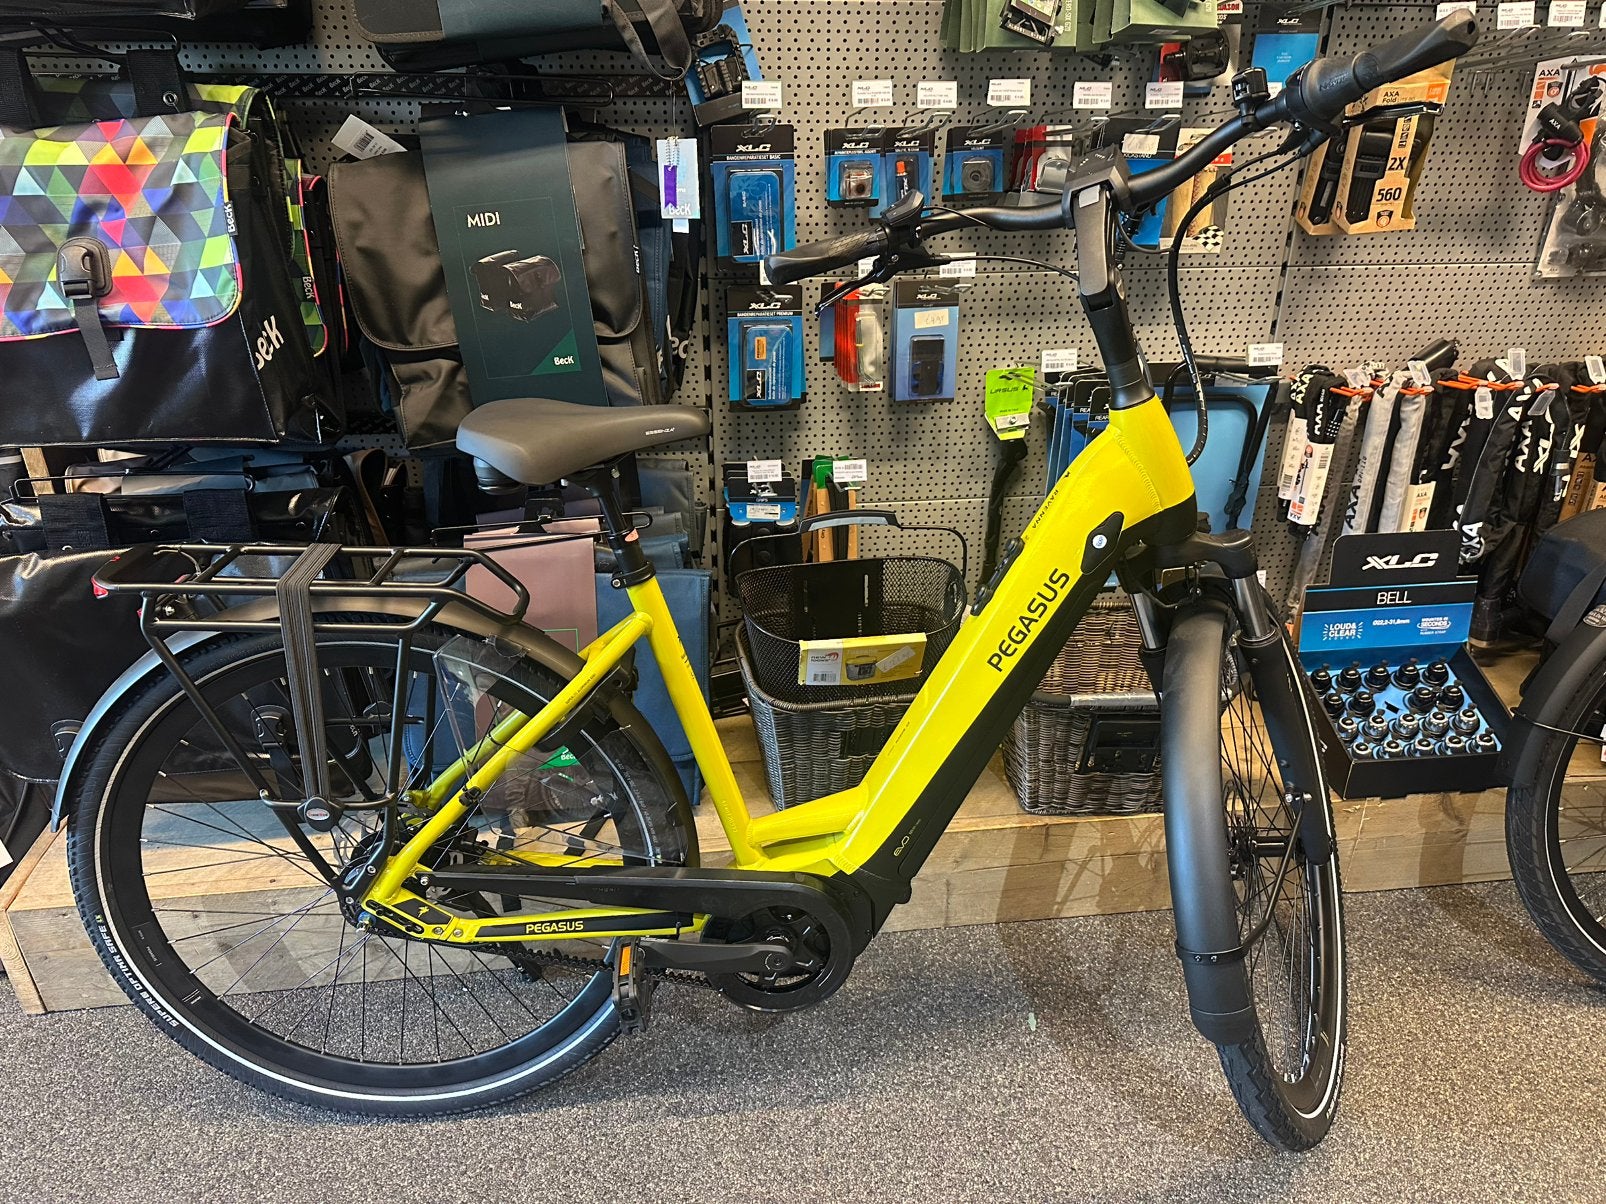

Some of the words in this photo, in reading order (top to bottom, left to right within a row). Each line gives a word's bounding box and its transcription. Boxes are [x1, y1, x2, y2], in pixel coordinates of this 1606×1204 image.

[1539, 68, 1560, 77] AXA
[1549, 118, 1561, 130] AXA
[736, 143, 771, 152] XLC
[964, 138, 991, 146] XLC
[1388, 156, 1406, 170] 2X
[1375, 187, 1402, 202] 560
[467, 211, 501, 228] MIDI
[741, 223, 749, 255] XLC
[749, 302, 781, 310] XLC
[255, 315, 284, 370] ecK
[553, 355, 574, 366] BecK
[990, 386, 1019, 394] URSUS
[1295, 373, 1314, 405] AXA
[1344, 485, 1360, 530] AXA
[1361, 553, 1439, 571] XLC
[1376, 590, 1412, 605] BELL
[986, 567, 1070, 672] PEGASUS
[1329, 622, 1357, 631] LOUD&
[1328, 629, 1356, 637] CLEAR
[525, 920, 585, 934] PEGASUS
[98, 925, 118, 954] SAFE
[113, 954, 143, 991] OPTIMA
